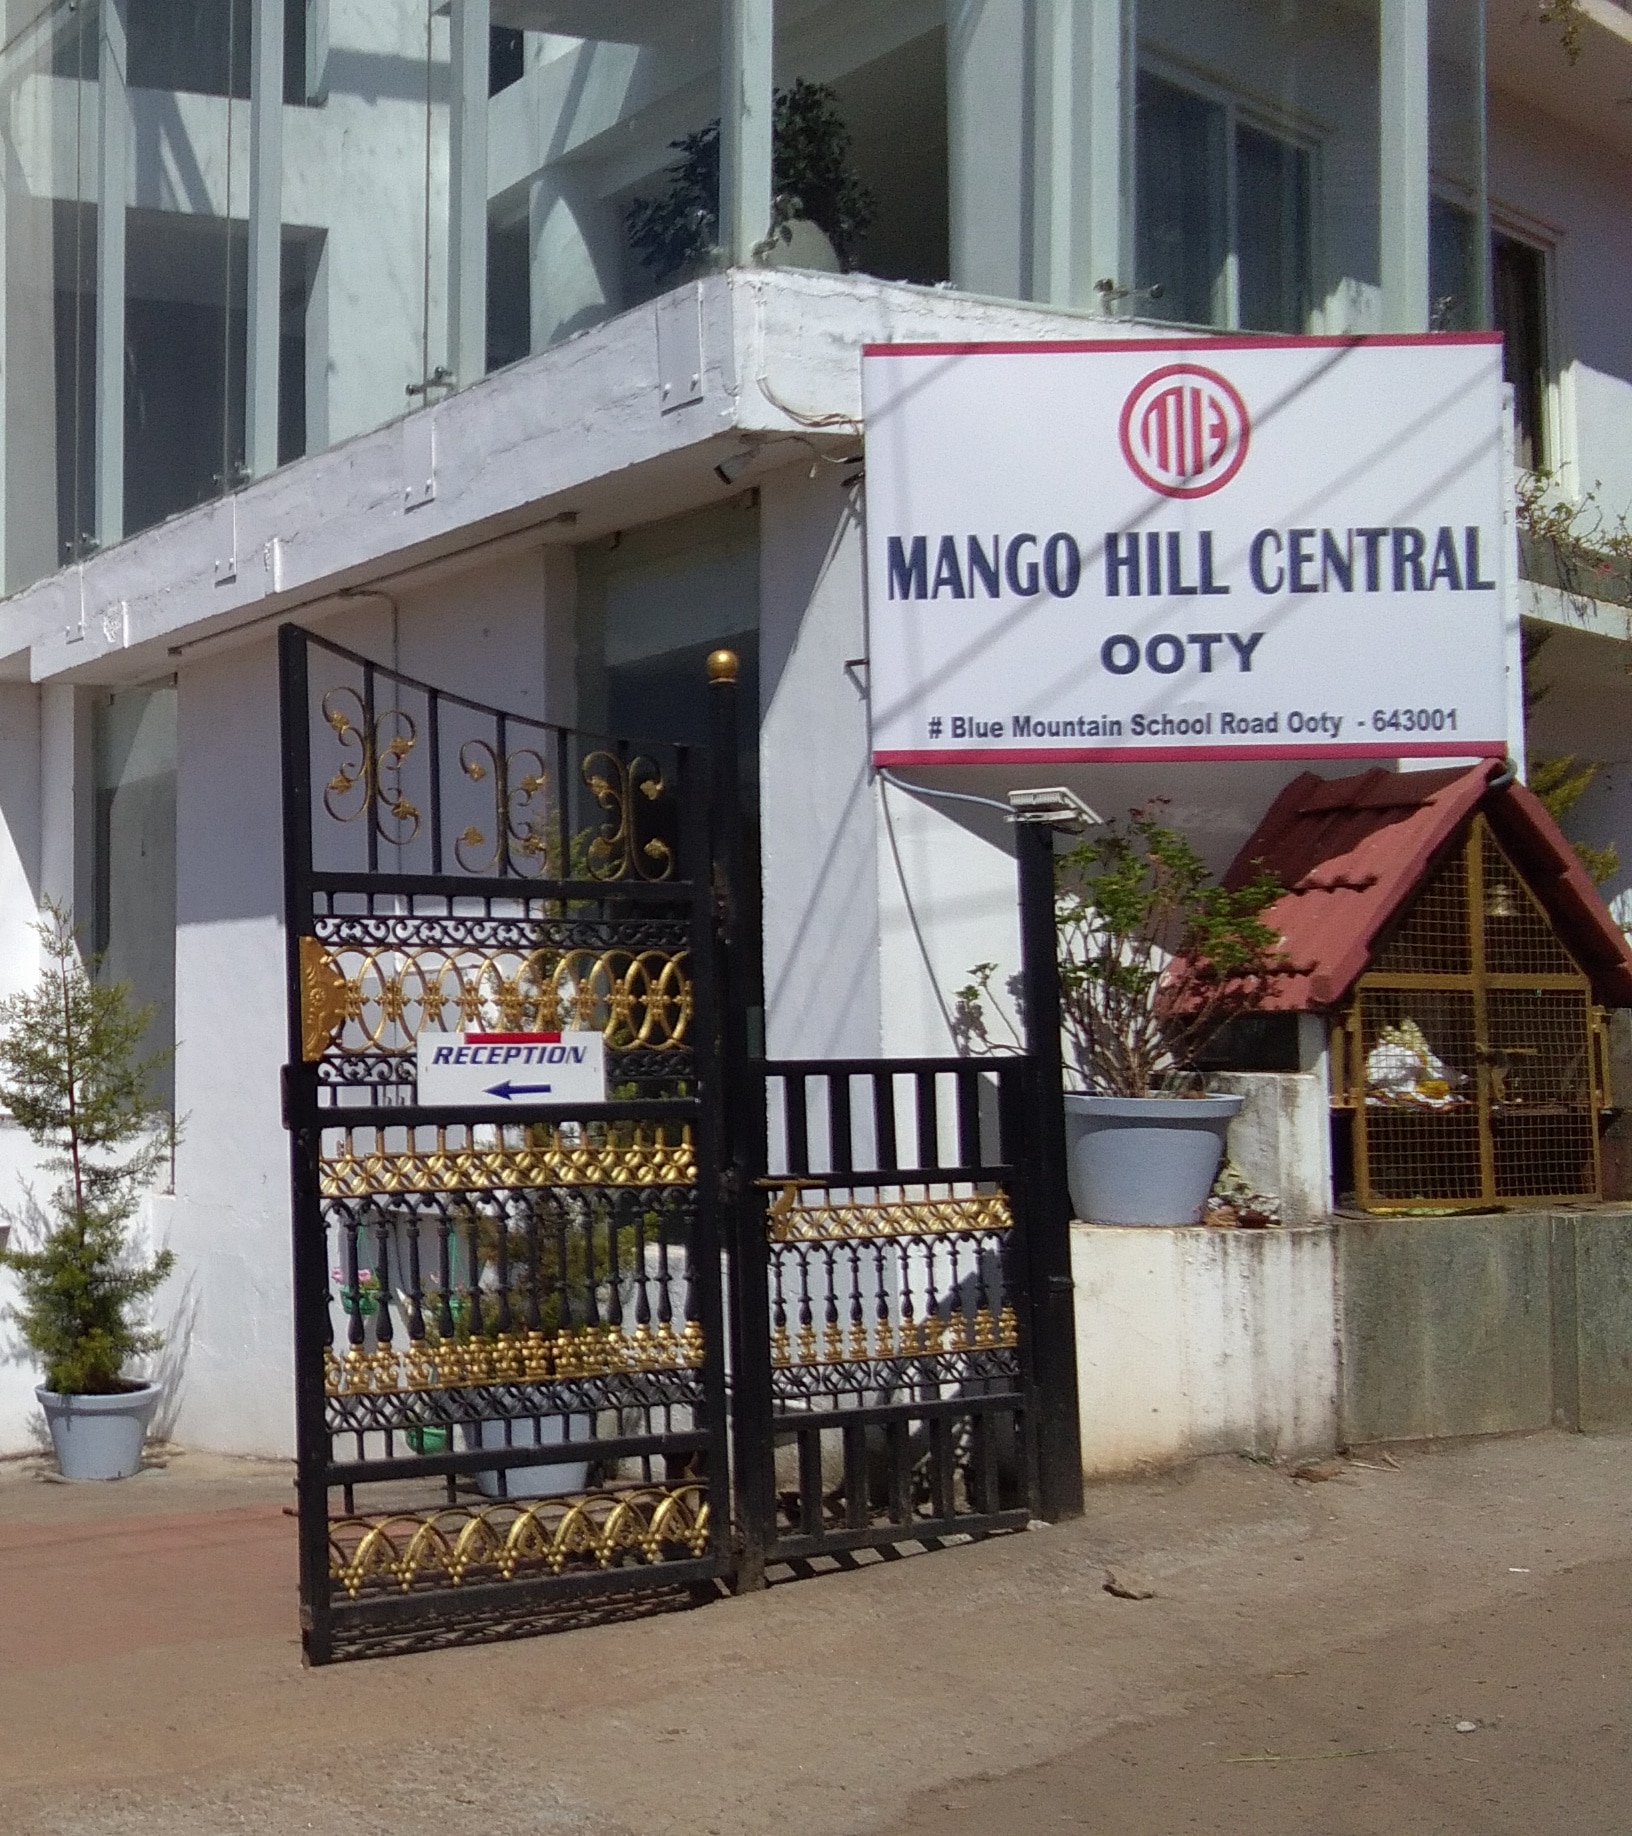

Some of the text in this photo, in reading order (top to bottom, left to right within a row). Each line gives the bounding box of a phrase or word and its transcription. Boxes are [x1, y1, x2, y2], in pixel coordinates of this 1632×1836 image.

[887, 526, 1497, 601] MANGO HILL CENTRAL
[1100, 632, 1266, 675] OOTY
[951, 715, 1005, 739] Blue
[1012, 714, 1123, 738] Mountain
[1130, 712, 1213, 737] School
[1220, 710, 1279, 736] Road
[1287, 710, 1344, 739] Ooty
[1372, 708, 1458, 733] 643001
[432, 1046, 588, 1065] RECEPTION
